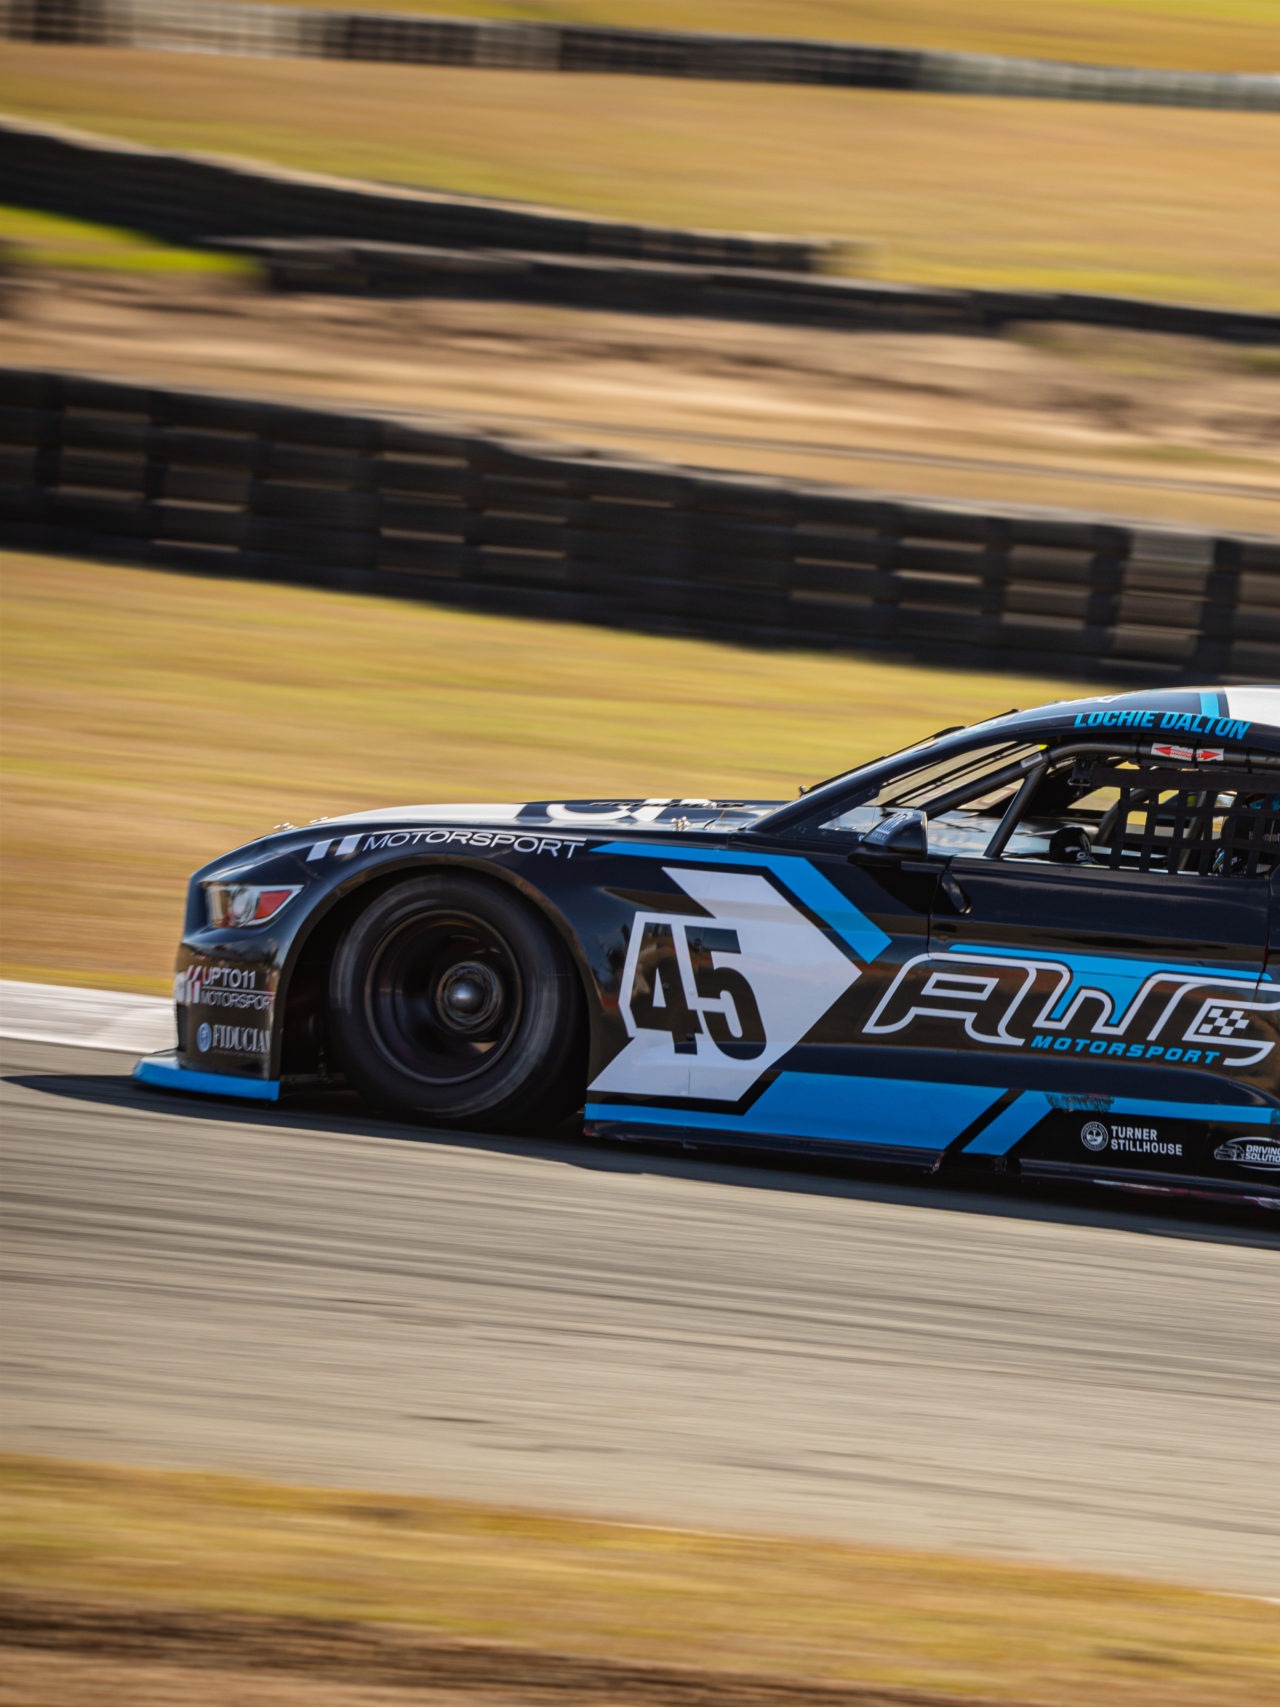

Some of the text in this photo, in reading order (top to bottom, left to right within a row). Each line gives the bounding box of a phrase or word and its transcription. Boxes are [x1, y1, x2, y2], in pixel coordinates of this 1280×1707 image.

[1074, 711, 1252, 740] LOCHIE DALTON
[362, 831, 587, 860] MOTORSPORT
[629, 922, 767, 1061] 45
[1031, 1035, 1221, 1065] MOTORSPORT
[1111, 1125, 1158, 1141] TURNER
[1111, 1139, 1183, 1156] STILLHOUSE
